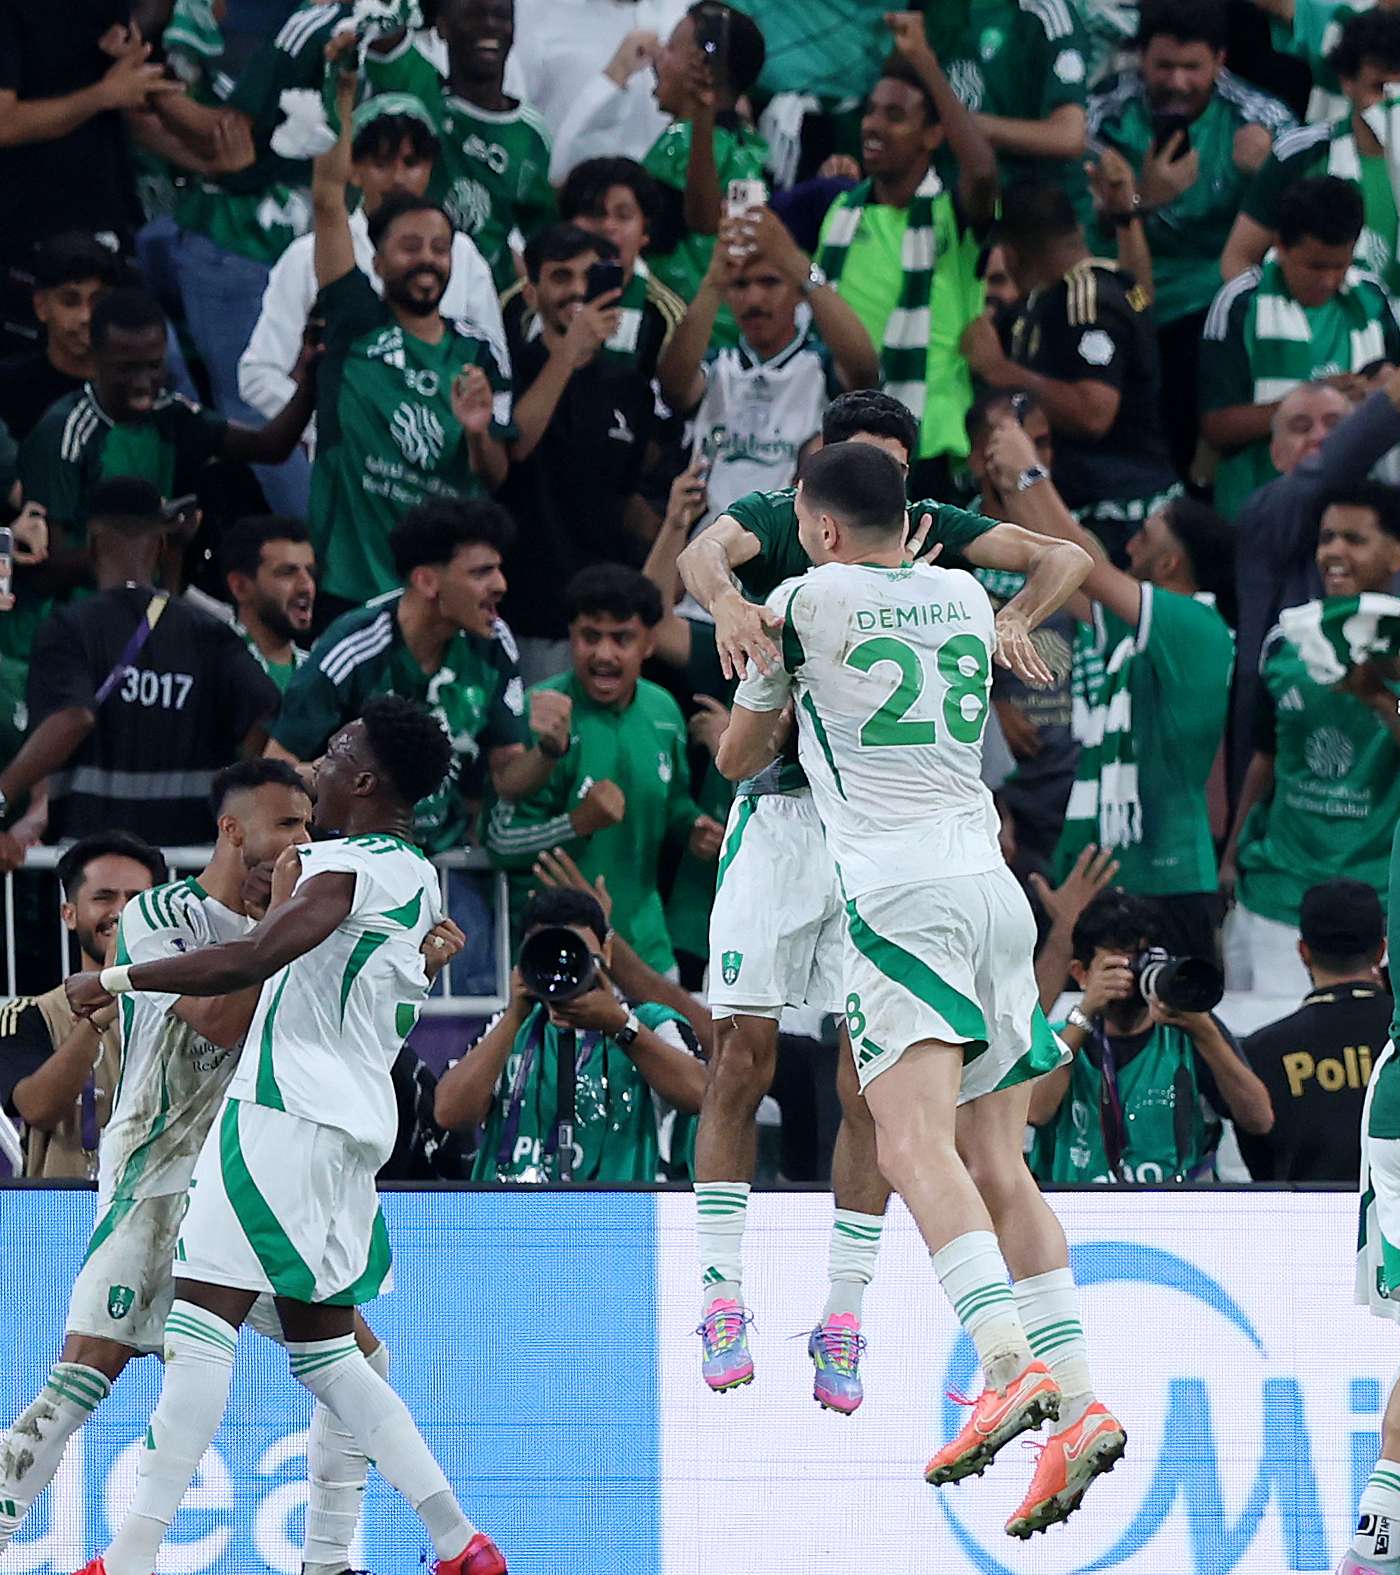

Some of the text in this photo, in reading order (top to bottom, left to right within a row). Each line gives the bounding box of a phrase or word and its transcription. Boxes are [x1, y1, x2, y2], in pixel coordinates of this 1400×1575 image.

[856, 601, 972, 630] DEMIRAL
[121, 665, 194, 710] 3017
[844, 632, 990, 748] 28
[846, 992, 867, 1040] 8
[1282, 1044, 1374, 1097] Poli
